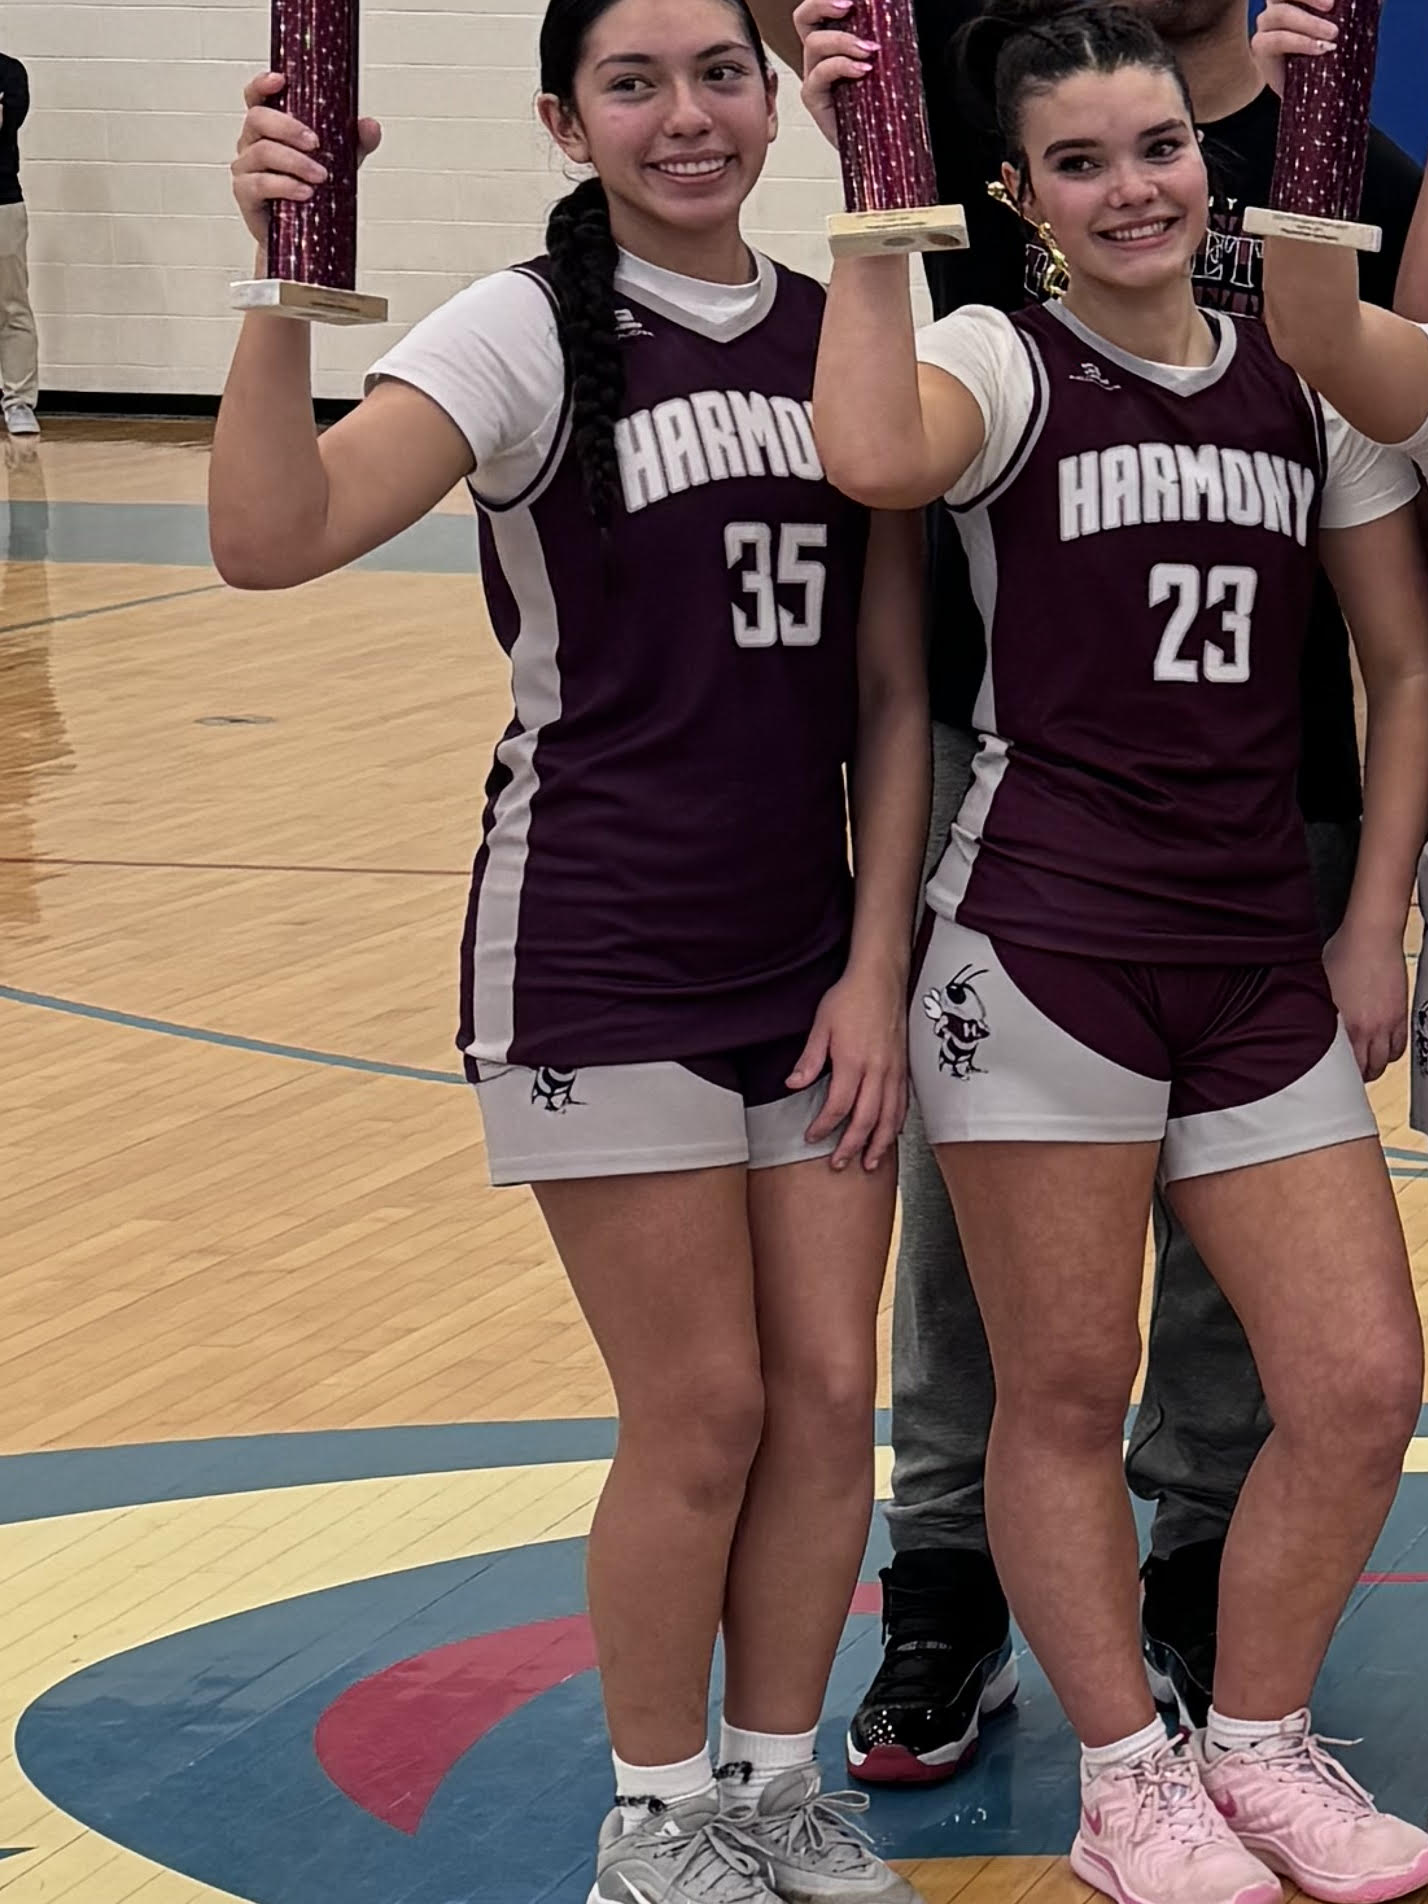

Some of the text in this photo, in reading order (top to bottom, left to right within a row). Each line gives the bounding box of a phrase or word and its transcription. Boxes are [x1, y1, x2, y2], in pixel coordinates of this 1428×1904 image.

[614, 391, 827, 513] HARMO
[1058, 442, 1315, 547] HARMONY
[724, 521, 828, 648] 35
[1149, 563, 1258, 683] 23
